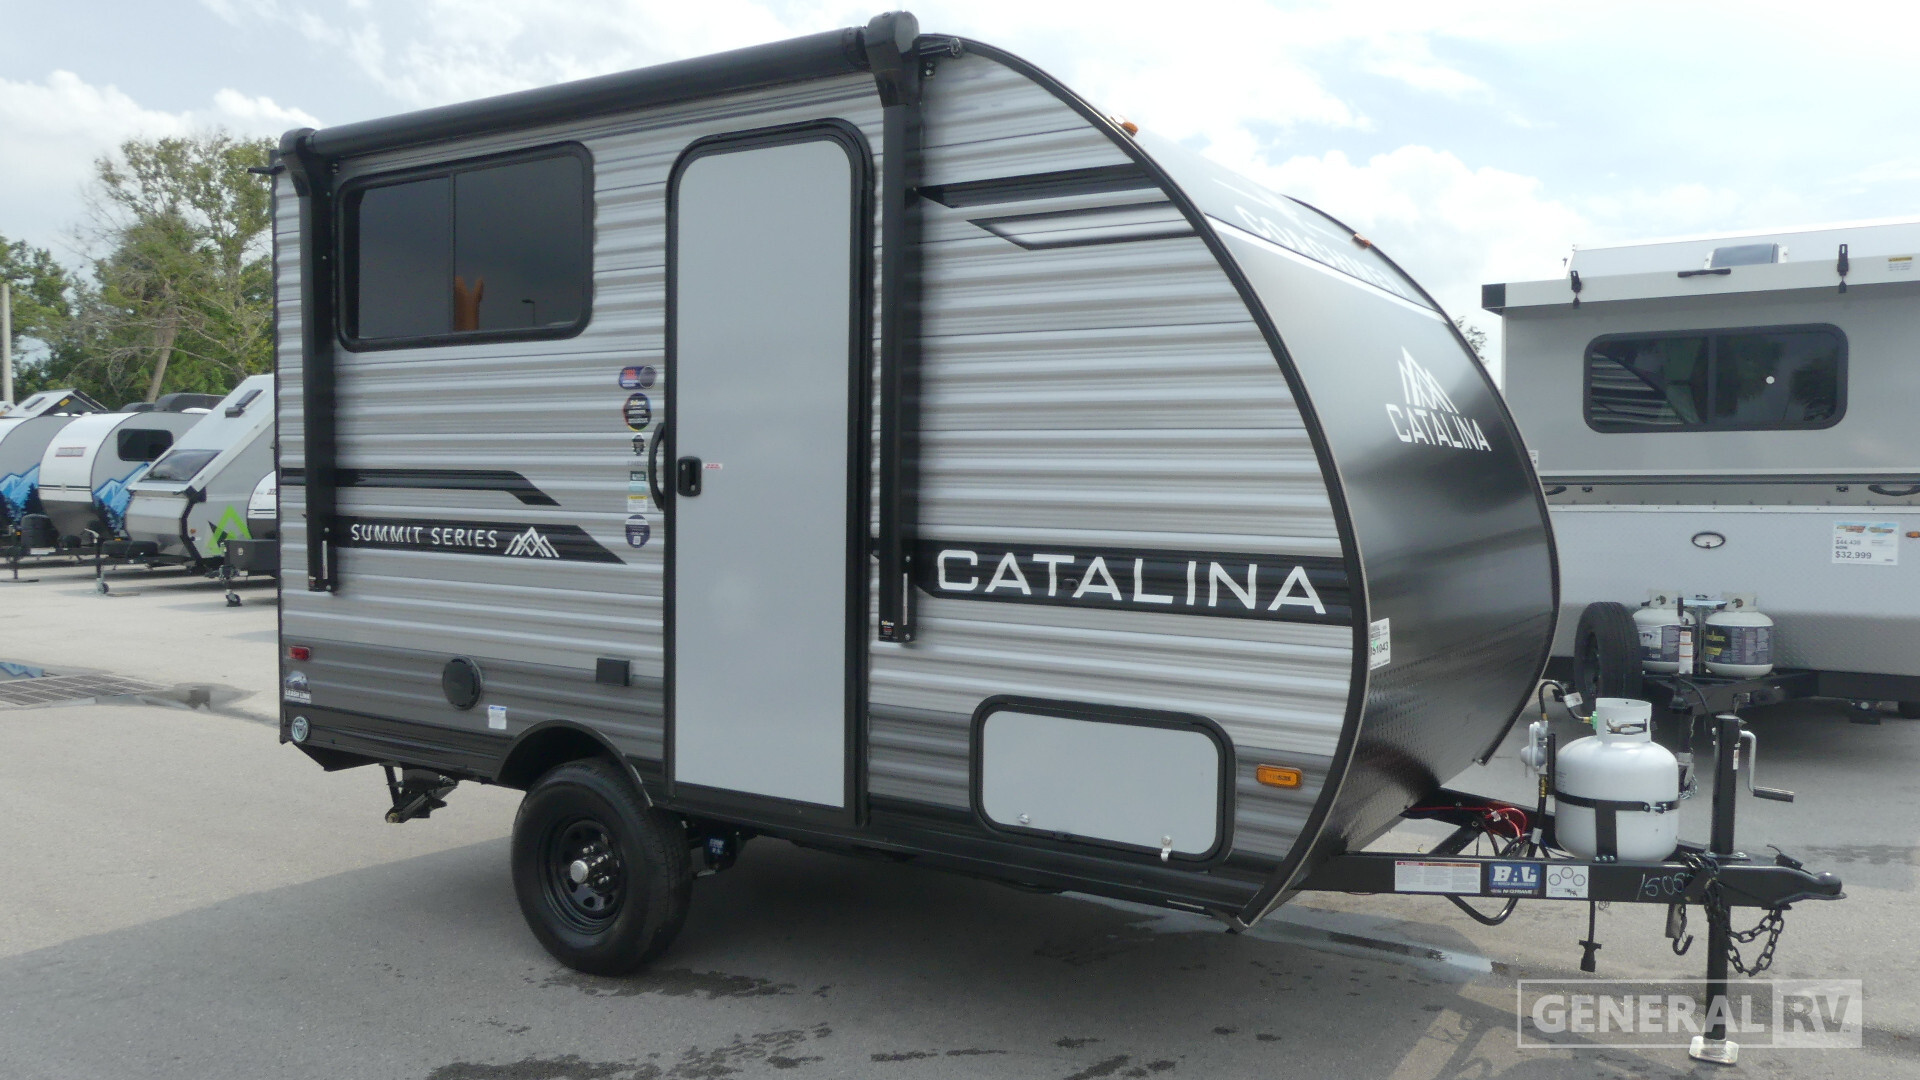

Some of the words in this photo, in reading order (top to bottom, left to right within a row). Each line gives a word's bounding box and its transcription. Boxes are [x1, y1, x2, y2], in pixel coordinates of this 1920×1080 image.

[1385, 403, 1492, 452] CATALINA
[351, 523, 424, 544] SUMMIT
[431, 527, 498, 548] SERIES
[1835, 550, 1872, 559] $32,999
[937, 549, 1327, 614] CATALINA
